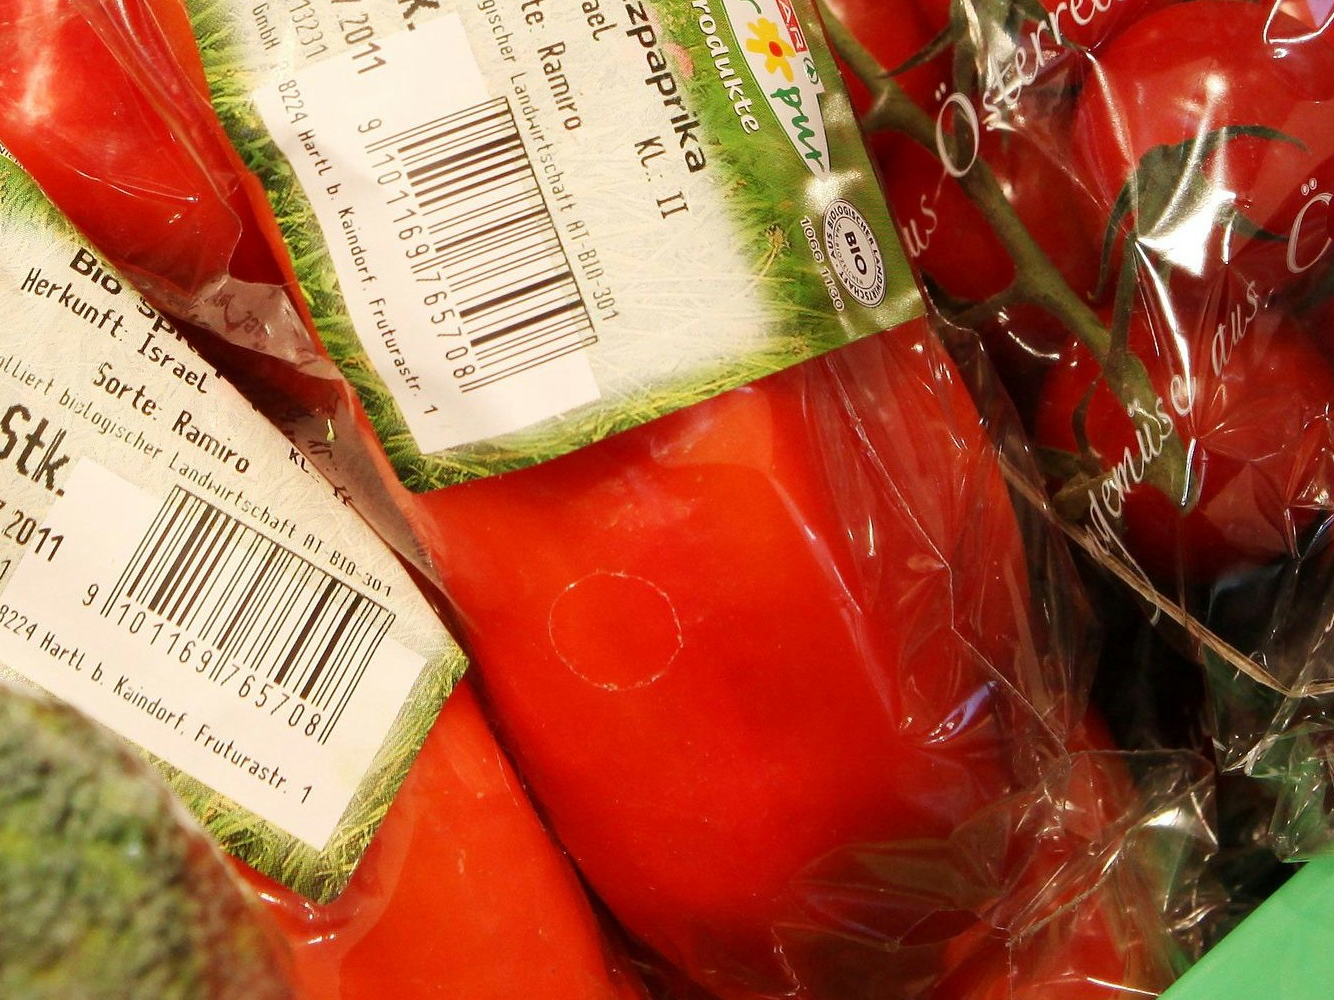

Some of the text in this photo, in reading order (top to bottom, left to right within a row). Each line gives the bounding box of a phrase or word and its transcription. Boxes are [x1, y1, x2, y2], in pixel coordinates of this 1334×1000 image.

[536, 40, 583, 132] Ramiro
[770, 85, 826, 174] pur
[251, 1, 282, 52] GmbH
[297, 127, 333, 178] Hartl
[325, 182, 341, 202] b.
[368, 297, 422, 398] Fruturastr.
[423, 404, 439, 416] 1
[510, 70, 577, 213] Landwirtschaft
[566, 219, 621, 323] AT-BIO-301
[655, 190, 690, 220] II
[827, 205, 874, 246] BIOLOGISCHER
[68, 246, 124, 297] Bio
[357, 117, 477, 380] 9 101169 765708
[799, 214, 845, 312] 1066 1130
[826, 231, 837, 260] AUS
[838, 248, 883, 300] LANDWIRTSCHAFT
[844, 230, 868, 276] BIO
[19, 266, 126, 343] Herkunft:
[135, 332, 210, 396] Israel
[1210, 280, 1261, 377] aus
[91, 361, 163, 421] Sorte:
[170, 409, 251, 476] Ramiro
[58, 388, 164, 463] biologischer
[167, 451, 298, 540] Landwirtschaft
[302, 532, 394, 599] AT-BIO-301
[81, 583, 324, 738] 9 101169 765708
[39, 632, 85, 672] Hartl
[90, 660, 105, 687] b.
[193, 723, 289, 796] Fruturastr.
[300, 784, 314, 805] 1
